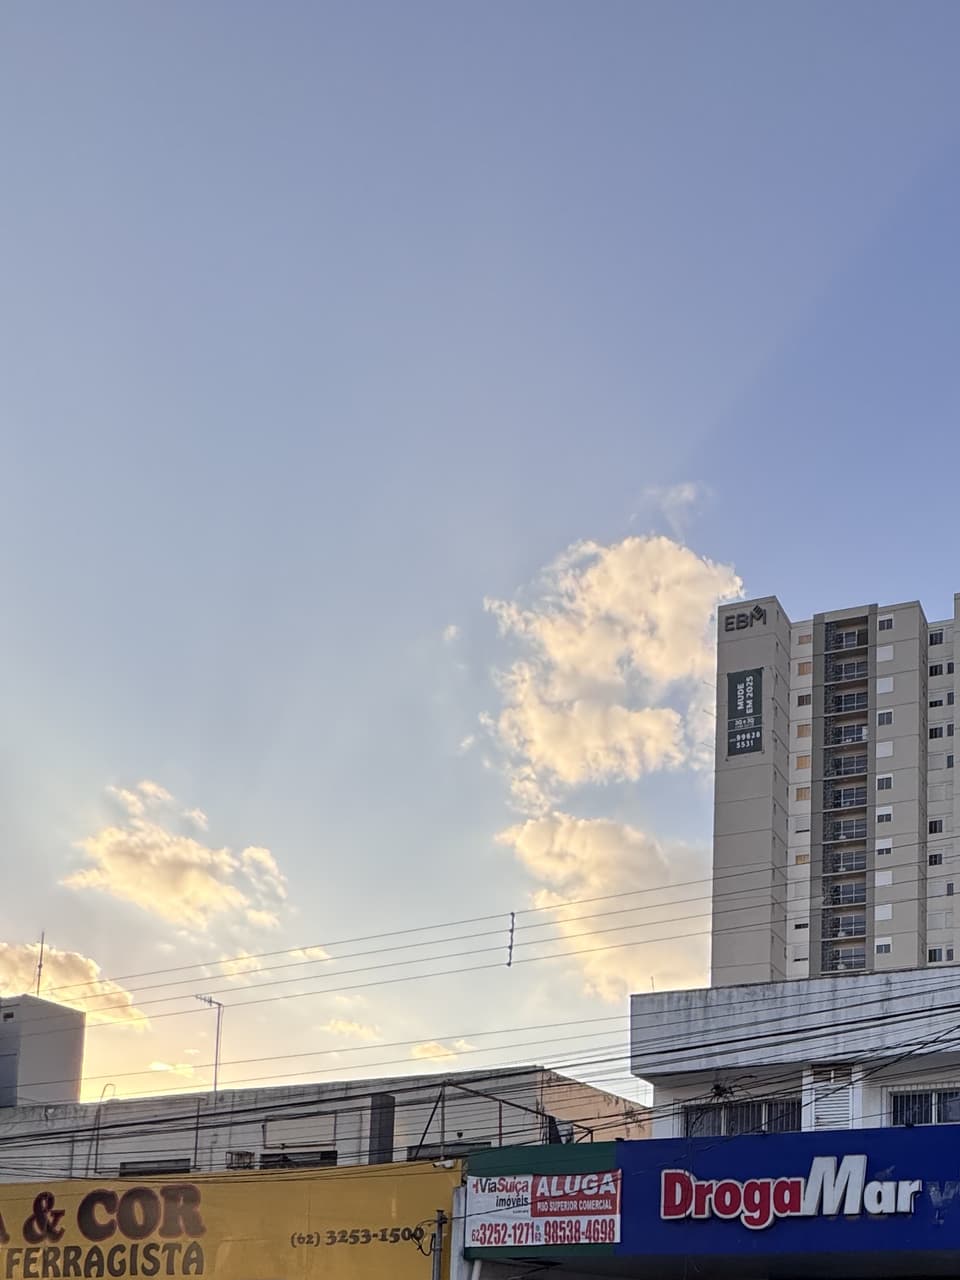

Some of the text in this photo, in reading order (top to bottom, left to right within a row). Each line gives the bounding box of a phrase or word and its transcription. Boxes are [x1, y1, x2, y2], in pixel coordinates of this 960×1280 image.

[724, 606, 767, 632] EBM
[737, 683, 745, 710] MUDE
[536, 1173, 617, 1197] ALUGA
[22, 1191, 66, 1244] &
[77, 1184, 207, 1242] COR
[549, 1201, 578, 1211] SUPERIOR
[578, 1199, 613, 1211] COMERCIAL
[291, 1227, 425, 1247] (62) 3253-1500
[480, 1222, 535, 1245] 3252-1271
[544, 1218, 616, 1244] 98538-4698
[6, 1241, 205, 1279] FERRAGISTA
